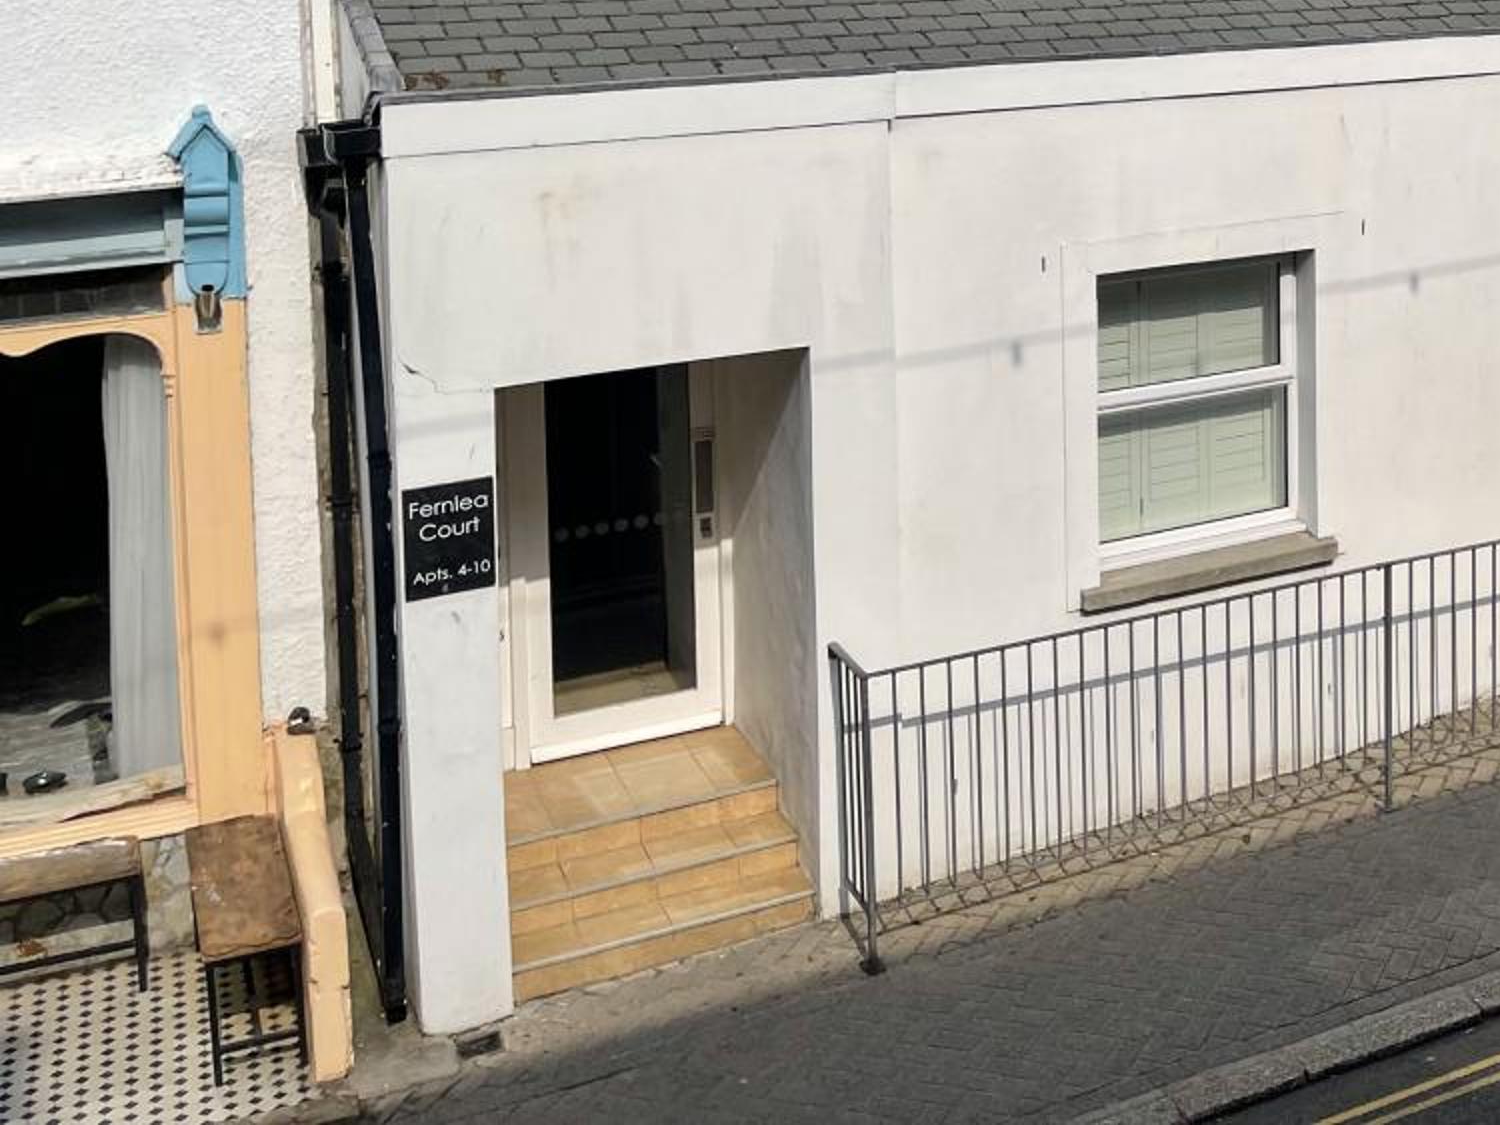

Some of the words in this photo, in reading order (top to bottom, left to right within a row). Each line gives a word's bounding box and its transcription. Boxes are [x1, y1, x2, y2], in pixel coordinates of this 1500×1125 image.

[408, 494, 489, 520] Fernlea
[419, 516, 480, 542] Court
[413, 567, 453, 586] Apts.
[457, 558, 491, 576] 4-10
